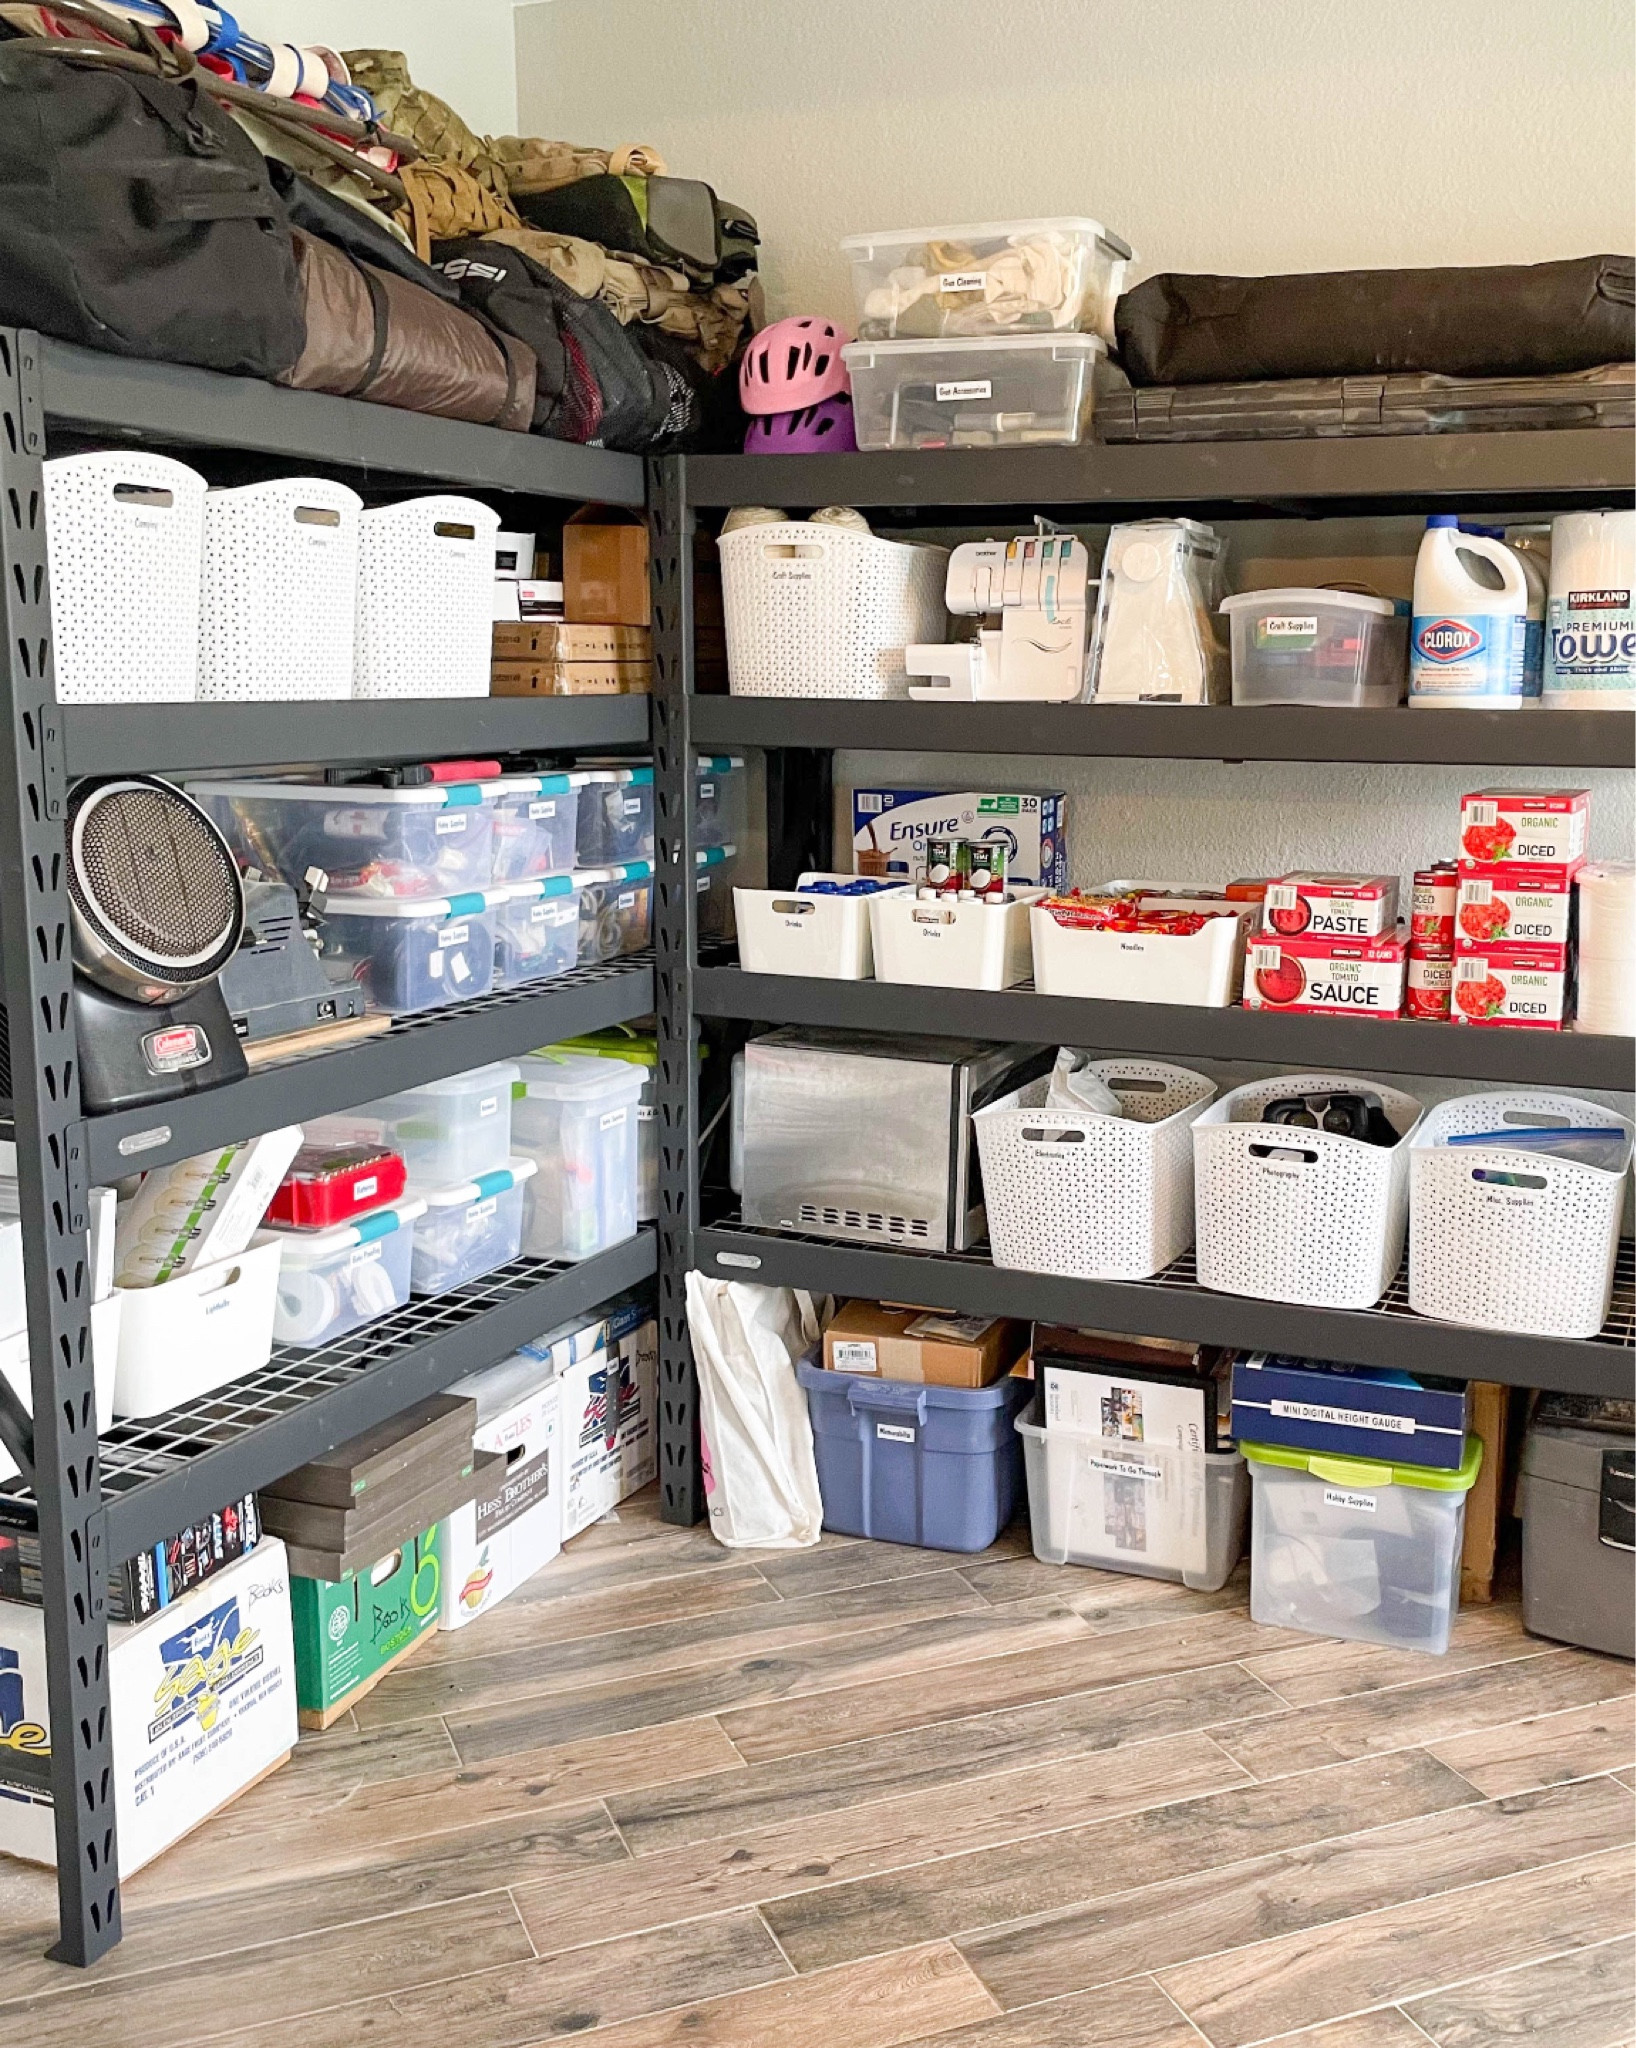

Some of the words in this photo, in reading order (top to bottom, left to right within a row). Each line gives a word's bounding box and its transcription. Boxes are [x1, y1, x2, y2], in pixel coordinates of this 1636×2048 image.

[1569, 591, 1629, 604] KIRKLAND
[1269, 620, 1285, 631] Craft
[1286, 620, 1314, 632] Supplies
[1424, 631, 1471, 648] CLOROX
[1021, 797, 1038, 808] 30
[1521, 817, 1558, 829] ORGANIC
[890, 818, 960, 842] Ensure
[1518, 844, 1556, 857] DICED
[1515, 896, 1553, 908] ORGANIC
[785, 919, 803, 928] Drinks
[1313, 915, 1369, 934] PASTE
[922, 928, 941, 938] Drinks
[1514, 924, 1553, 936] DICED
[1120, 943, 1145, 951] Noodles
[1329, 962, 1362, 973] ORGANIC
[1331, 972, 1359, 982] TOMATO
[1511, 975, 1548, 987] ORGANIC
[1309, 982, 1379, 1005] SAUCE
[1509, 1002, 1547, 1014] DICED
[1262, 1167, 1299, 1179] Photography
[1283, 1404, 1301, 1416] MINI
[1302, 1407, 1336, 1420] DIGITAL
[1337, 1411, 1370, 1425] HEIGHT
[1371, 1416, 1402, 1430] GAUGE
[1090, 1458, 1118, 1471] Paperwork
[1119, 1465, 1126, 1473] To
[1127, 1466, 1137, 1475] Go
[1138, 1467, 1162, 1479] Through
[1326, 1492, 1345, 1504] Hobby
[1347, 1495, 1374, 1508] Supplies
